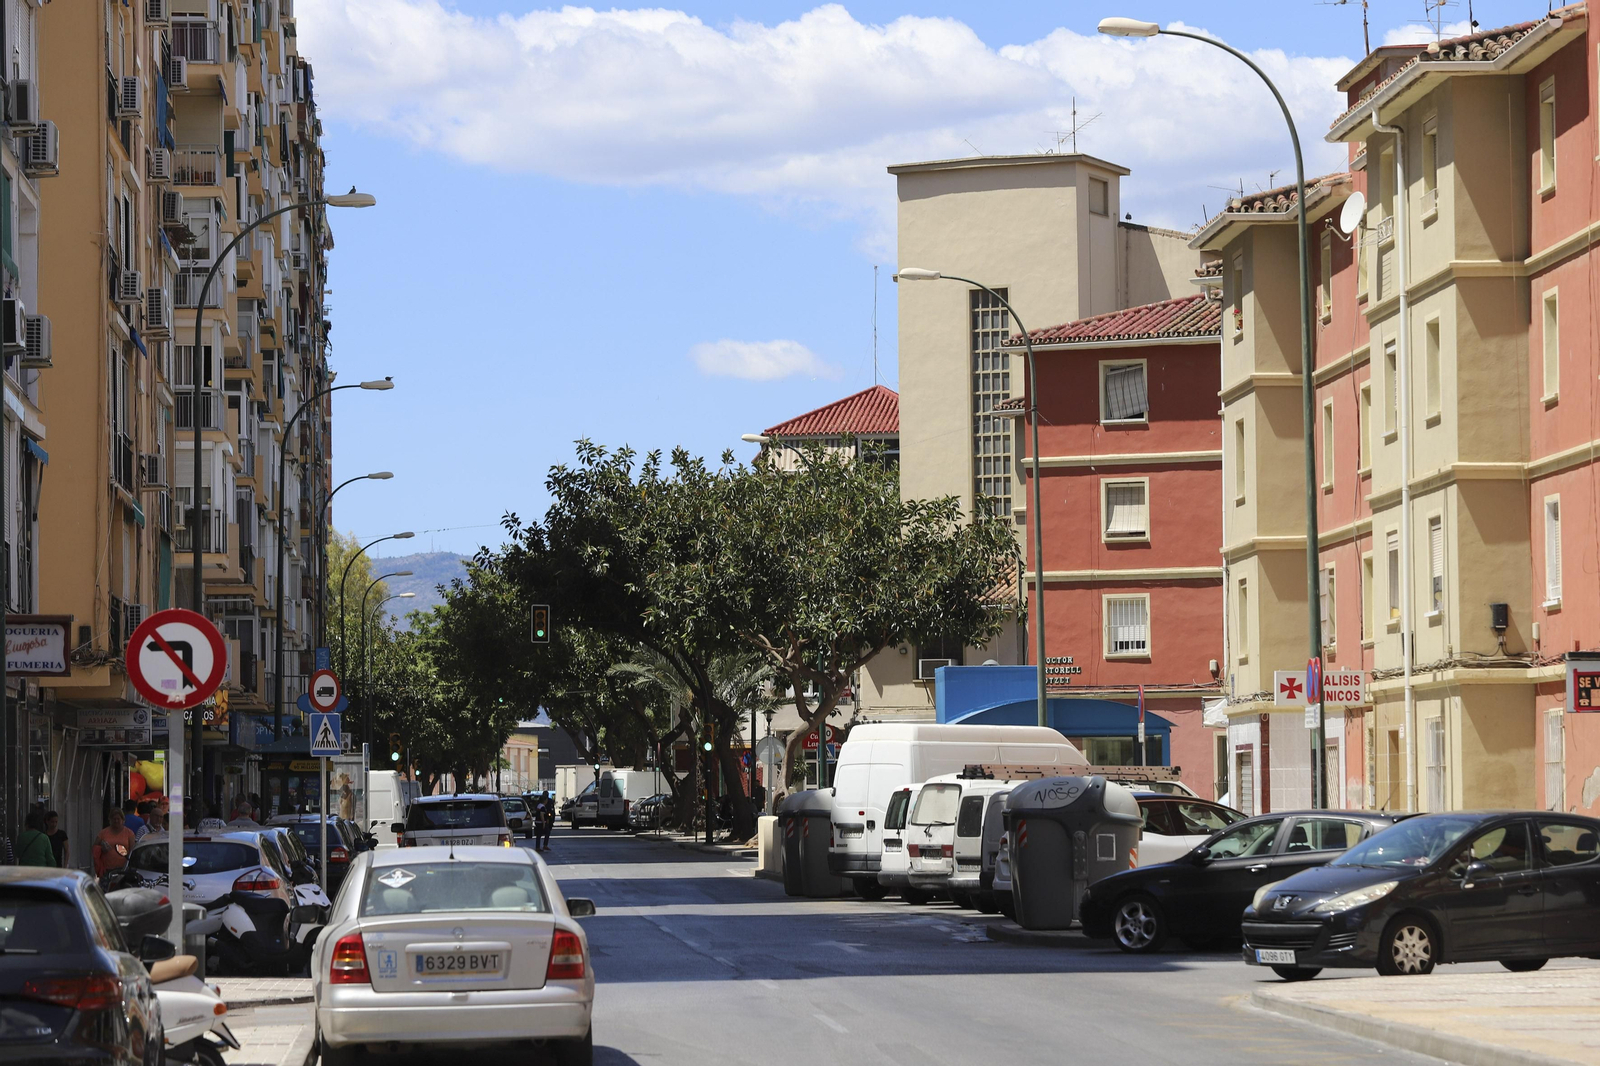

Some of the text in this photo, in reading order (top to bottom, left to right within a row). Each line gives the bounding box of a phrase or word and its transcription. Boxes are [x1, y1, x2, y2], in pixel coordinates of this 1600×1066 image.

[5, 627, 59, 636] OGUERIA
[8, 661, 63, 669] FUMERIA
[1046, 656, 1073, 664] OCTOR
[1324, 674, 1360, 686] ALISIS
[1579, 676, 1591, 688] SE
[1323, 690, 1360, 702] INICOS
[425, 954, 499, 969] 6329 BVT
